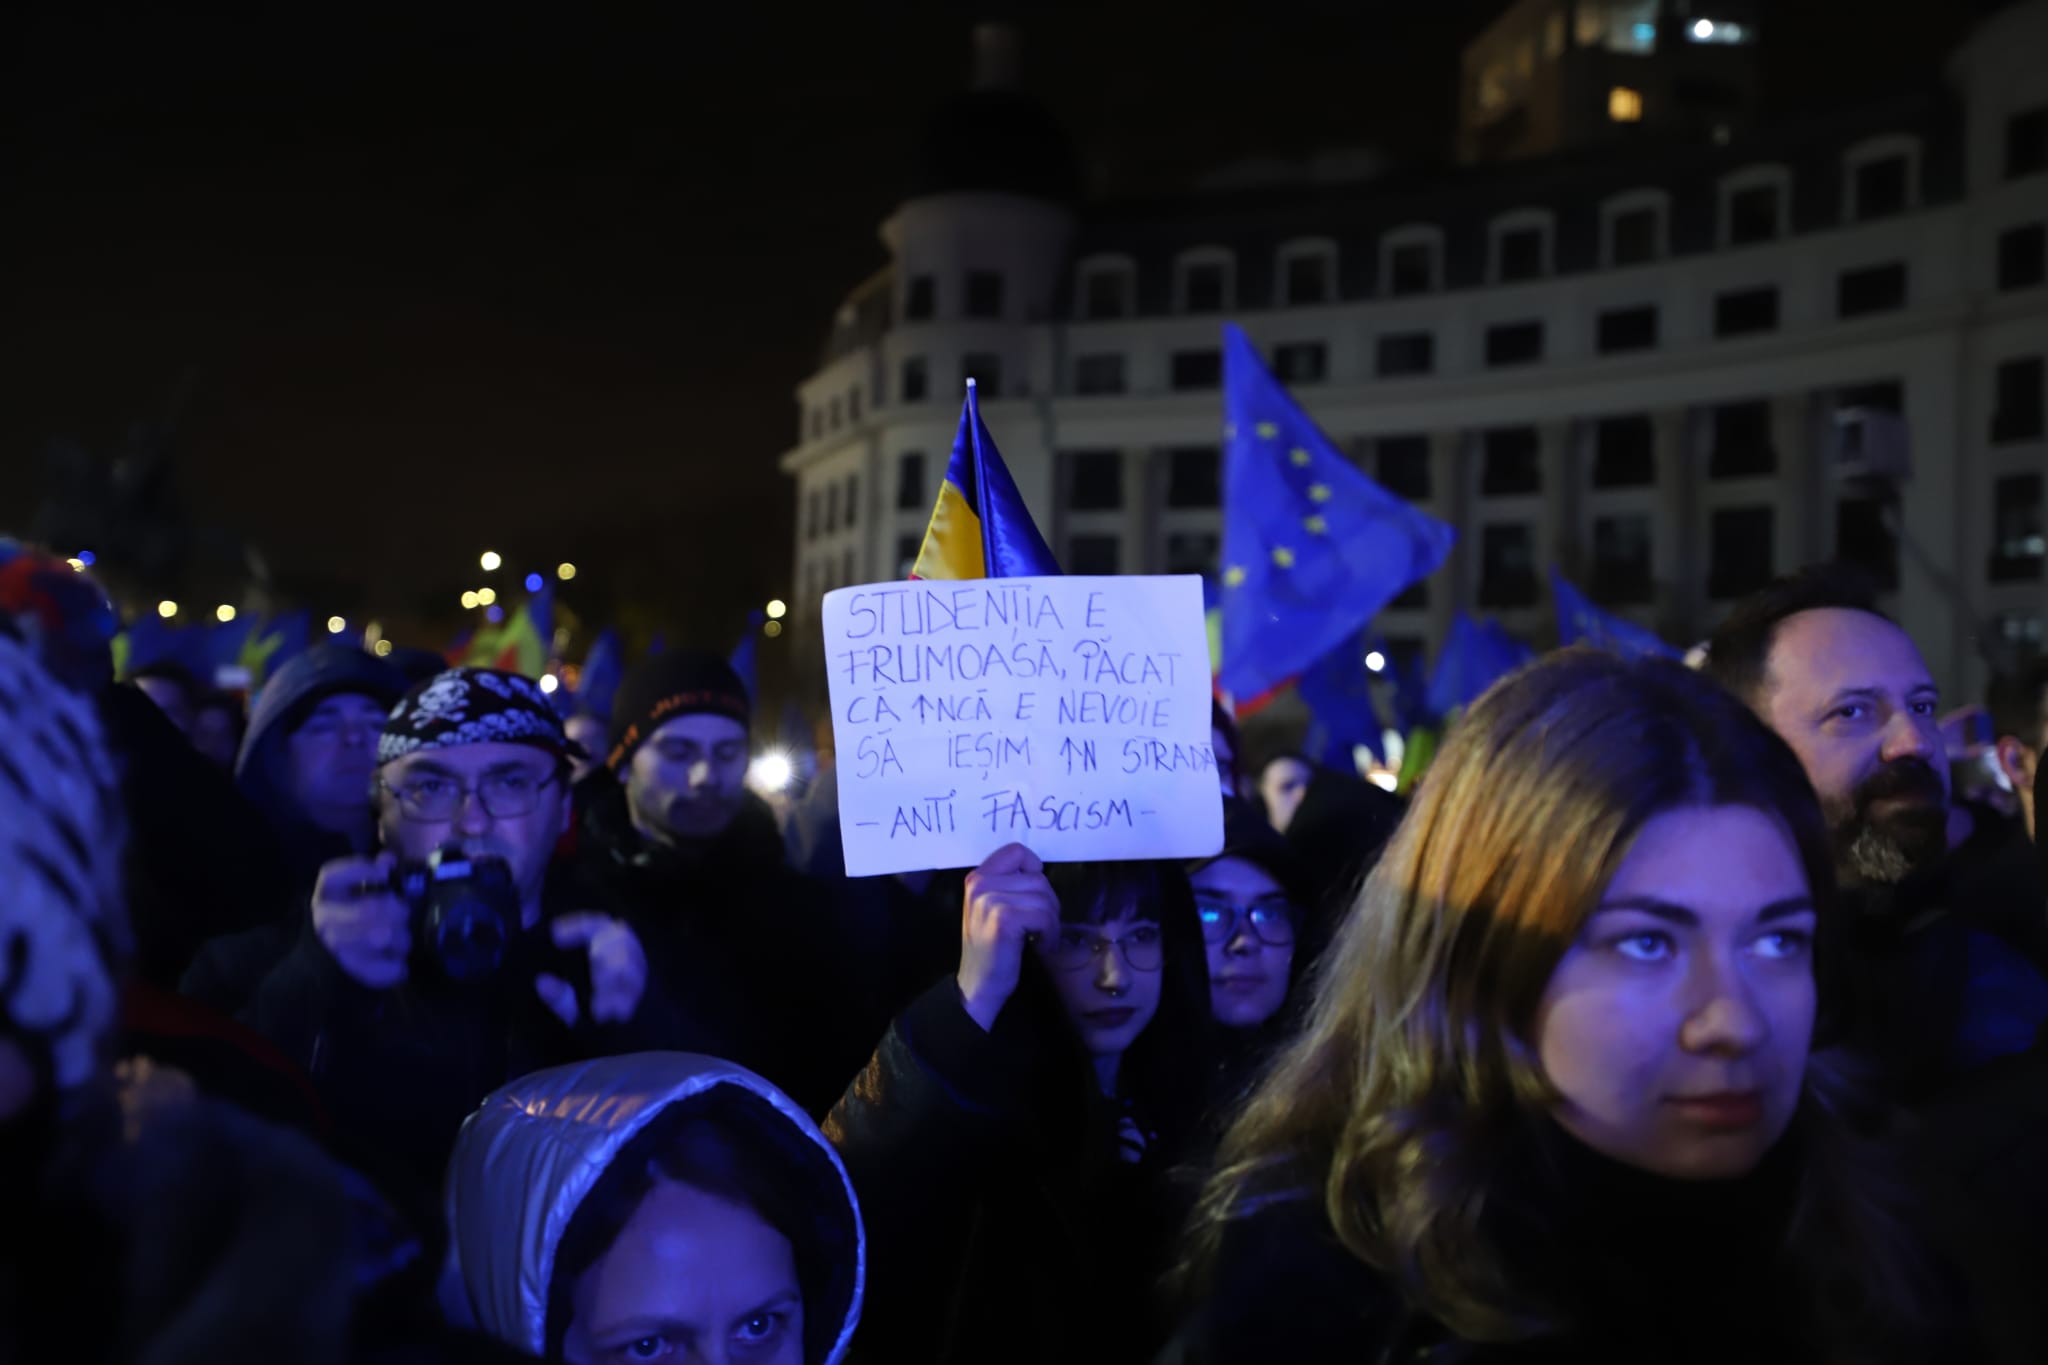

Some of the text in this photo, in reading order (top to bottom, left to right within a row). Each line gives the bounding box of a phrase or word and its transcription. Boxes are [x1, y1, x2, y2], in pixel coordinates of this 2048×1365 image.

[1085, 591, 1107, 630] E
[837, 637, 1181, 689] FRUMOASĂ, PĂCAT
[846, 686, 902, 725] CĂ
[1015, 691, 1036, 721] E
[1058, 689, 1172, 728] NEVOIE
[855, 727, 904, 779] SĂ
